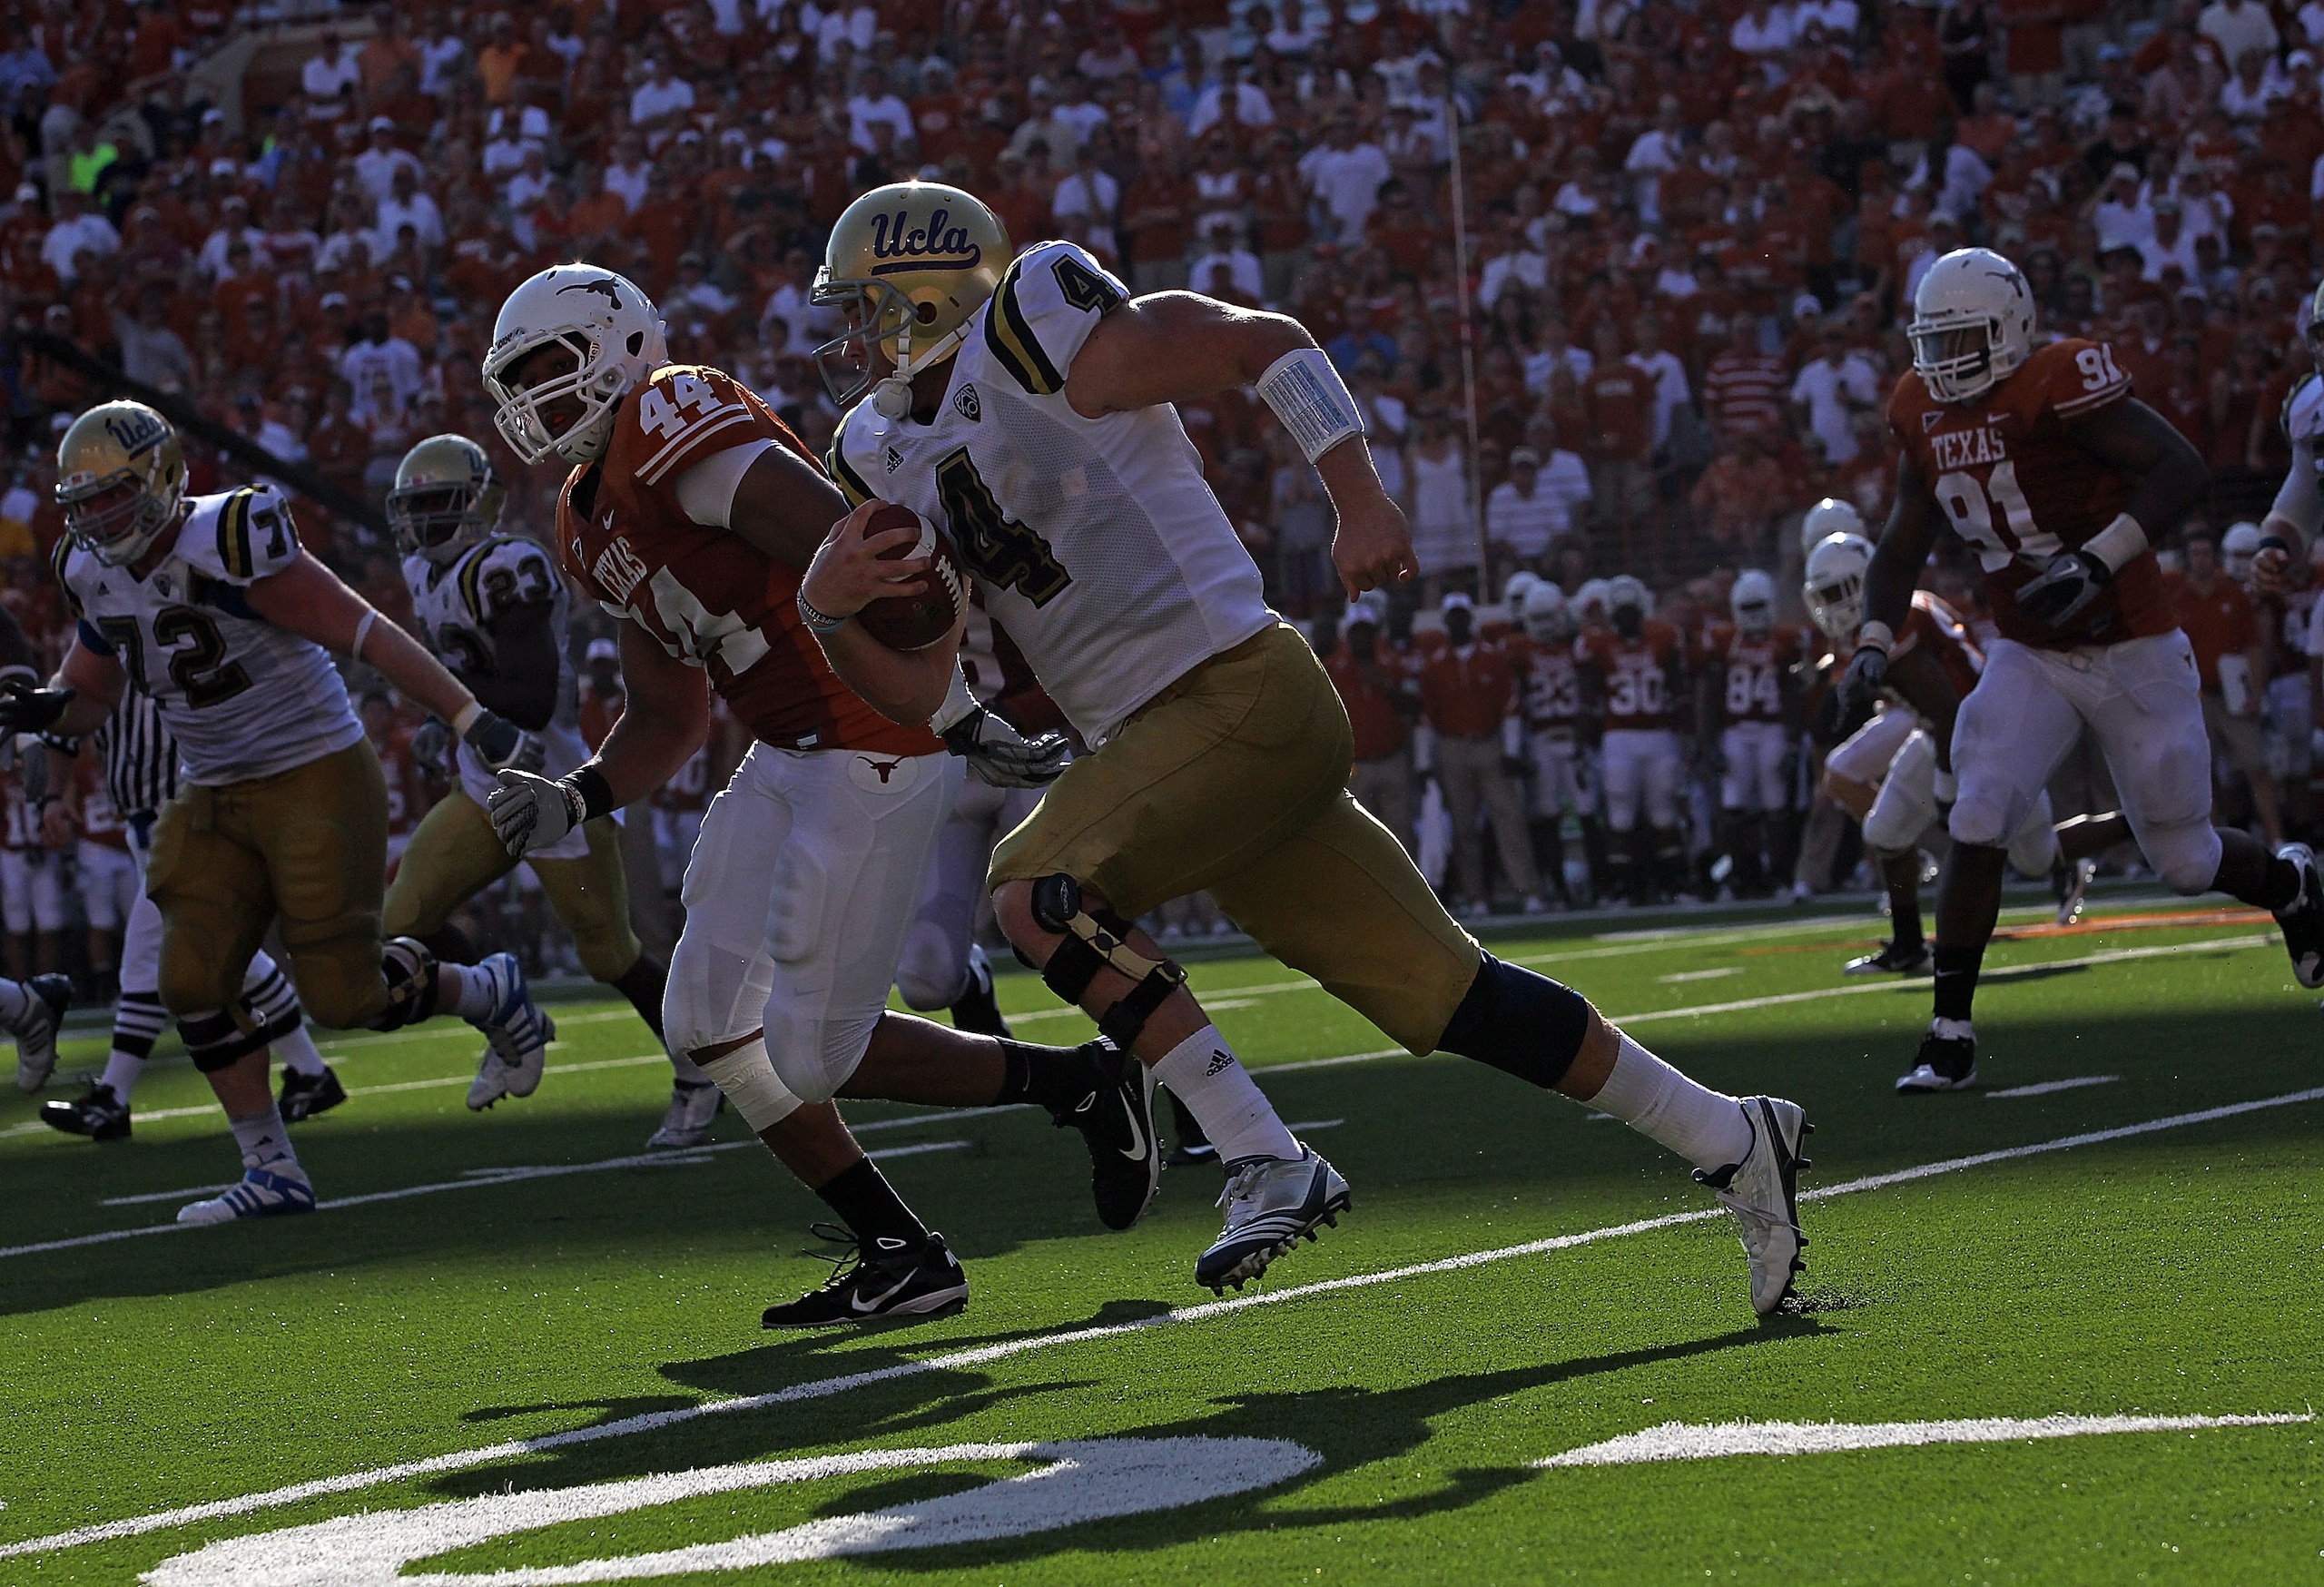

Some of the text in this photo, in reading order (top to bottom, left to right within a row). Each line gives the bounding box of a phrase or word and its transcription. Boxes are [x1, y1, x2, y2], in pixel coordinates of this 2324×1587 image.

[871, 209, 981, 275] Ucla
[1049, 253, 1124, 317] 4
[2074, 343, 2123, 391] 91
[638, 373, 723, 440] 44
[1930, 428, 2006, 471] TEXAS
[936, 445, 1073, 610] 4
[1935, 460, 2068, 573] 91
[483, 555, 551, 606] 23
[592, 536, 648, 607] TEXAS
[96, 608, 256, 709] 72
[1726, 665, 1782, 715] 84
[1606, 667, 1665, 716] 30
[1206, 1054, 1236, 1077] adidas
